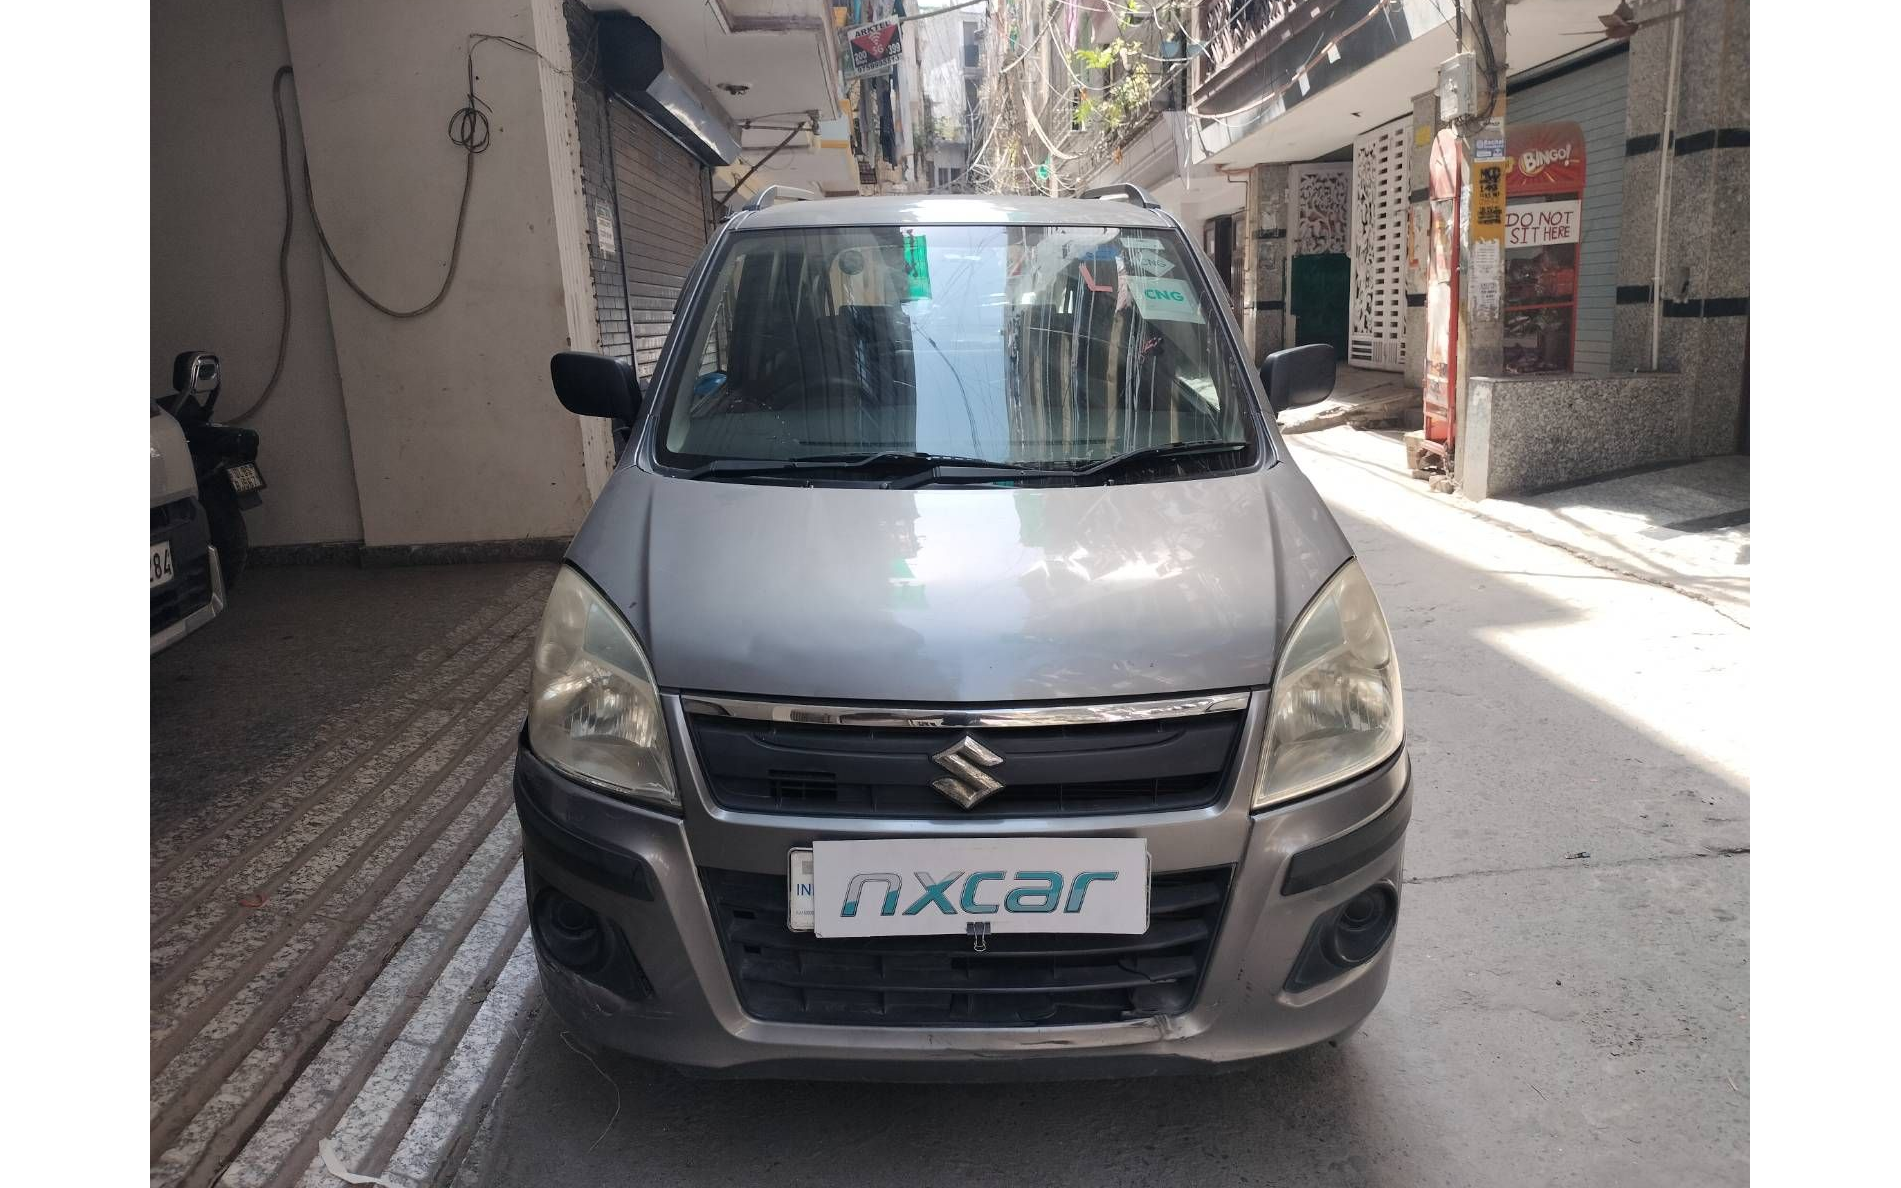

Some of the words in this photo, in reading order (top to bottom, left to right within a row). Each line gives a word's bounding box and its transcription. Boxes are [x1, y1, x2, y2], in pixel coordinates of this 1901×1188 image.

[855, 20, 890, 37] ARKTEL
[854, 50, 867, 61] 200
[887, 42, 901, 55] 399
[1523, 143, 1571, 172] BINGO!
[1505, 212, 1534, 228] DO
[1539, 211, 1574, 226] NOT
[1510, 227, 1540, 245] SIT
[1543, 225, 1571, 241] HERE
[1144, 288, 1185, 302] CNG
[796, 883, 814, 896] IN
[840, 870, 1120, 919] nxcar
